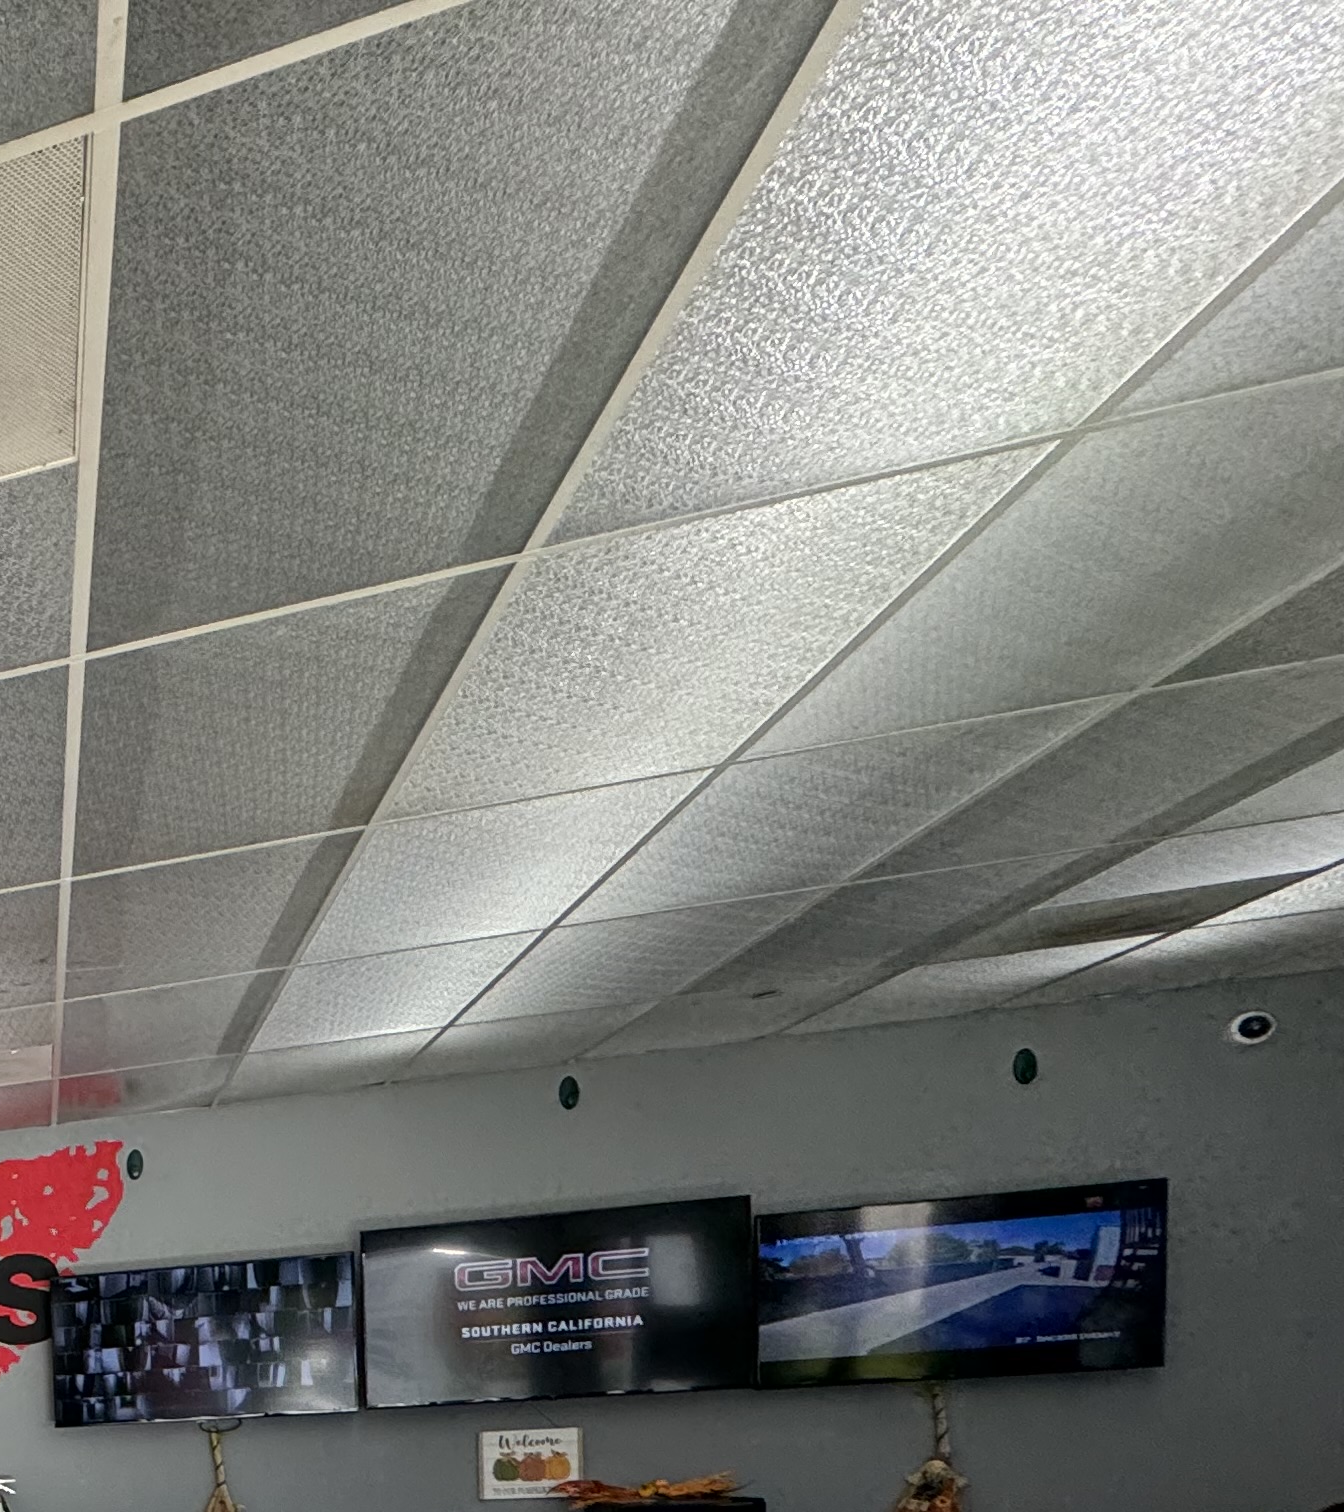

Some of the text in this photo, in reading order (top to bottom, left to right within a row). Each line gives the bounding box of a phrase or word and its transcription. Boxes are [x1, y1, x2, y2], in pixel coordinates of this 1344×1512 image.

[454, 1248, 649, 1291] GMC
[457, 1286, 649, 1312] WE ARE PROFESSIONAL GRADE
[461, 1315, 644, 1339] SOUTHERN CALIFORNIA
[511, 1339, 593, 1355] GMC Dealers
[498, 1435, 563, 1449] Welcome
